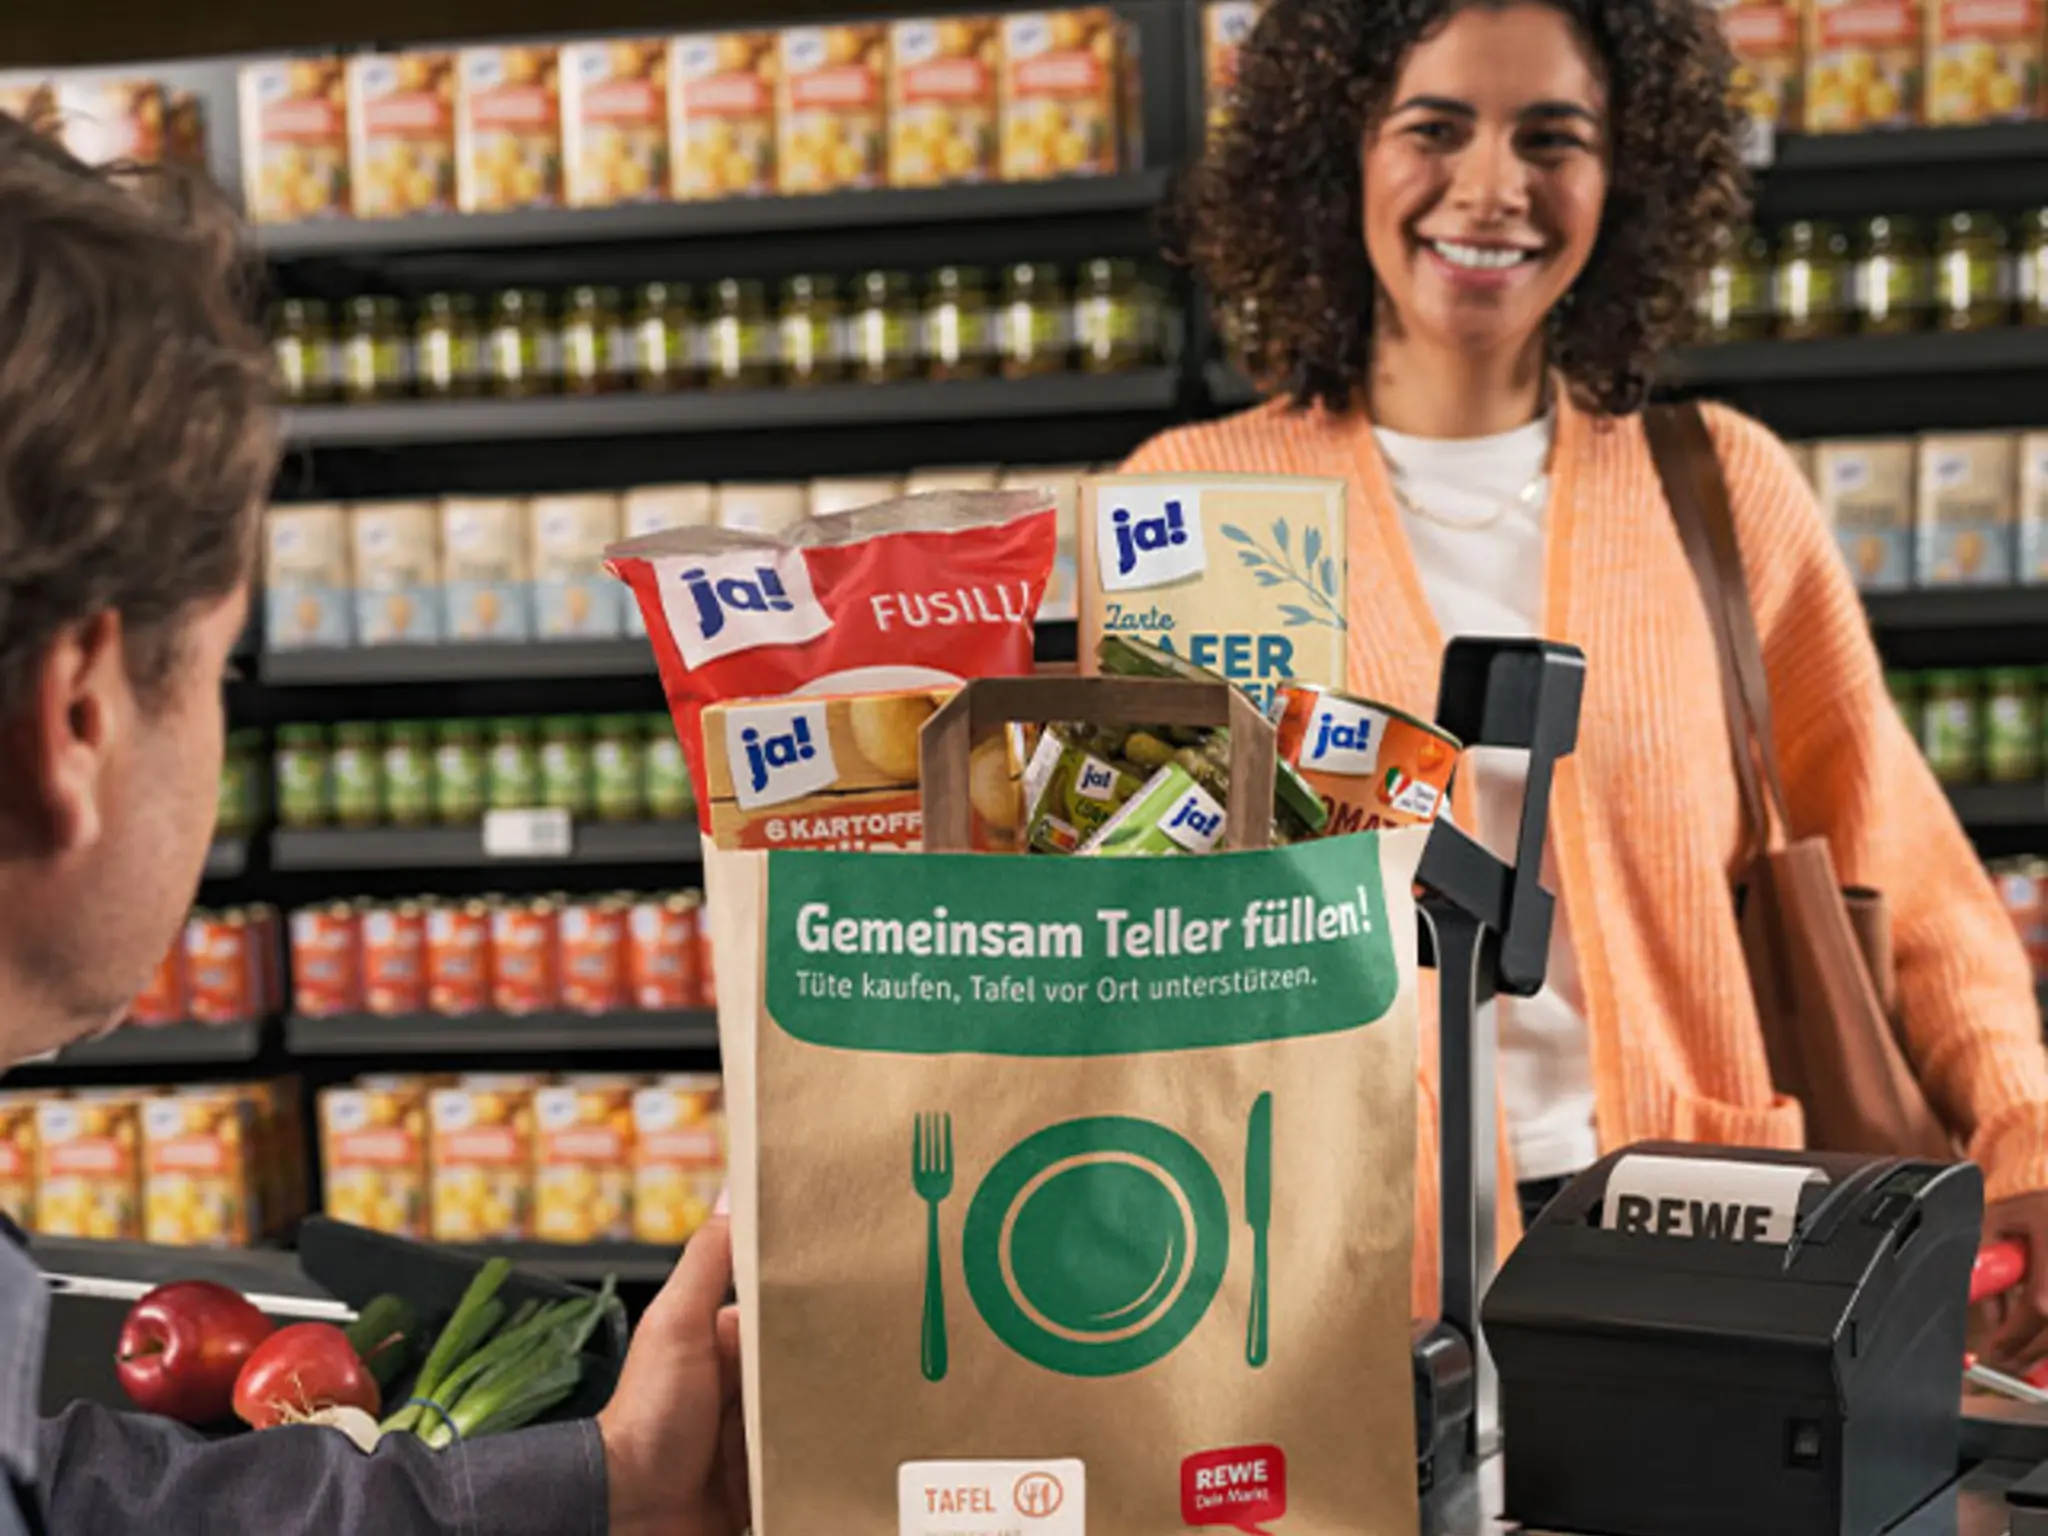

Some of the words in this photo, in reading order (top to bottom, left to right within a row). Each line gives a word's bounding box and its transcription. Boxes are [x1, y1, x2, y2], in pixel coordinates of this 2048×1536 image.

[1112, 499, 1188, 575] ja!
[680, 567, 794, 640] ja!
[870, 581, 1030, 632] FUSILLI
[1103, 603, 1176, 631] Zarte
[740, 716, 816, 793] ja!
[1312, 713, 1371, 760] ja!
[1081, 763, 1112, 789] ja!
[764, 818, 787, 842] 6
[1169, 797, 1222, 838] ja!
[796, 902, 1083, 958] Gemeinsam
[1096, 906, 1231, 958] Teller
[1241, 884, 1373, 950] füllen!
[796, 970, 853, 998] Tüte
[862, 972, 962, 1005] kaufen,
[969, 975, 1036, 1004] Tafel
[1044, 981, 1089, 1002] vor
[1097, 976, 1140, 1003] Ort
[1150, 965, 1319, 1001] unterstützen.
[1616, 1194, 1774, 1245] REWE
[1195, 1458, 1269, 1491] REWE
[924, 1487, 998, 1513] TAFEL
